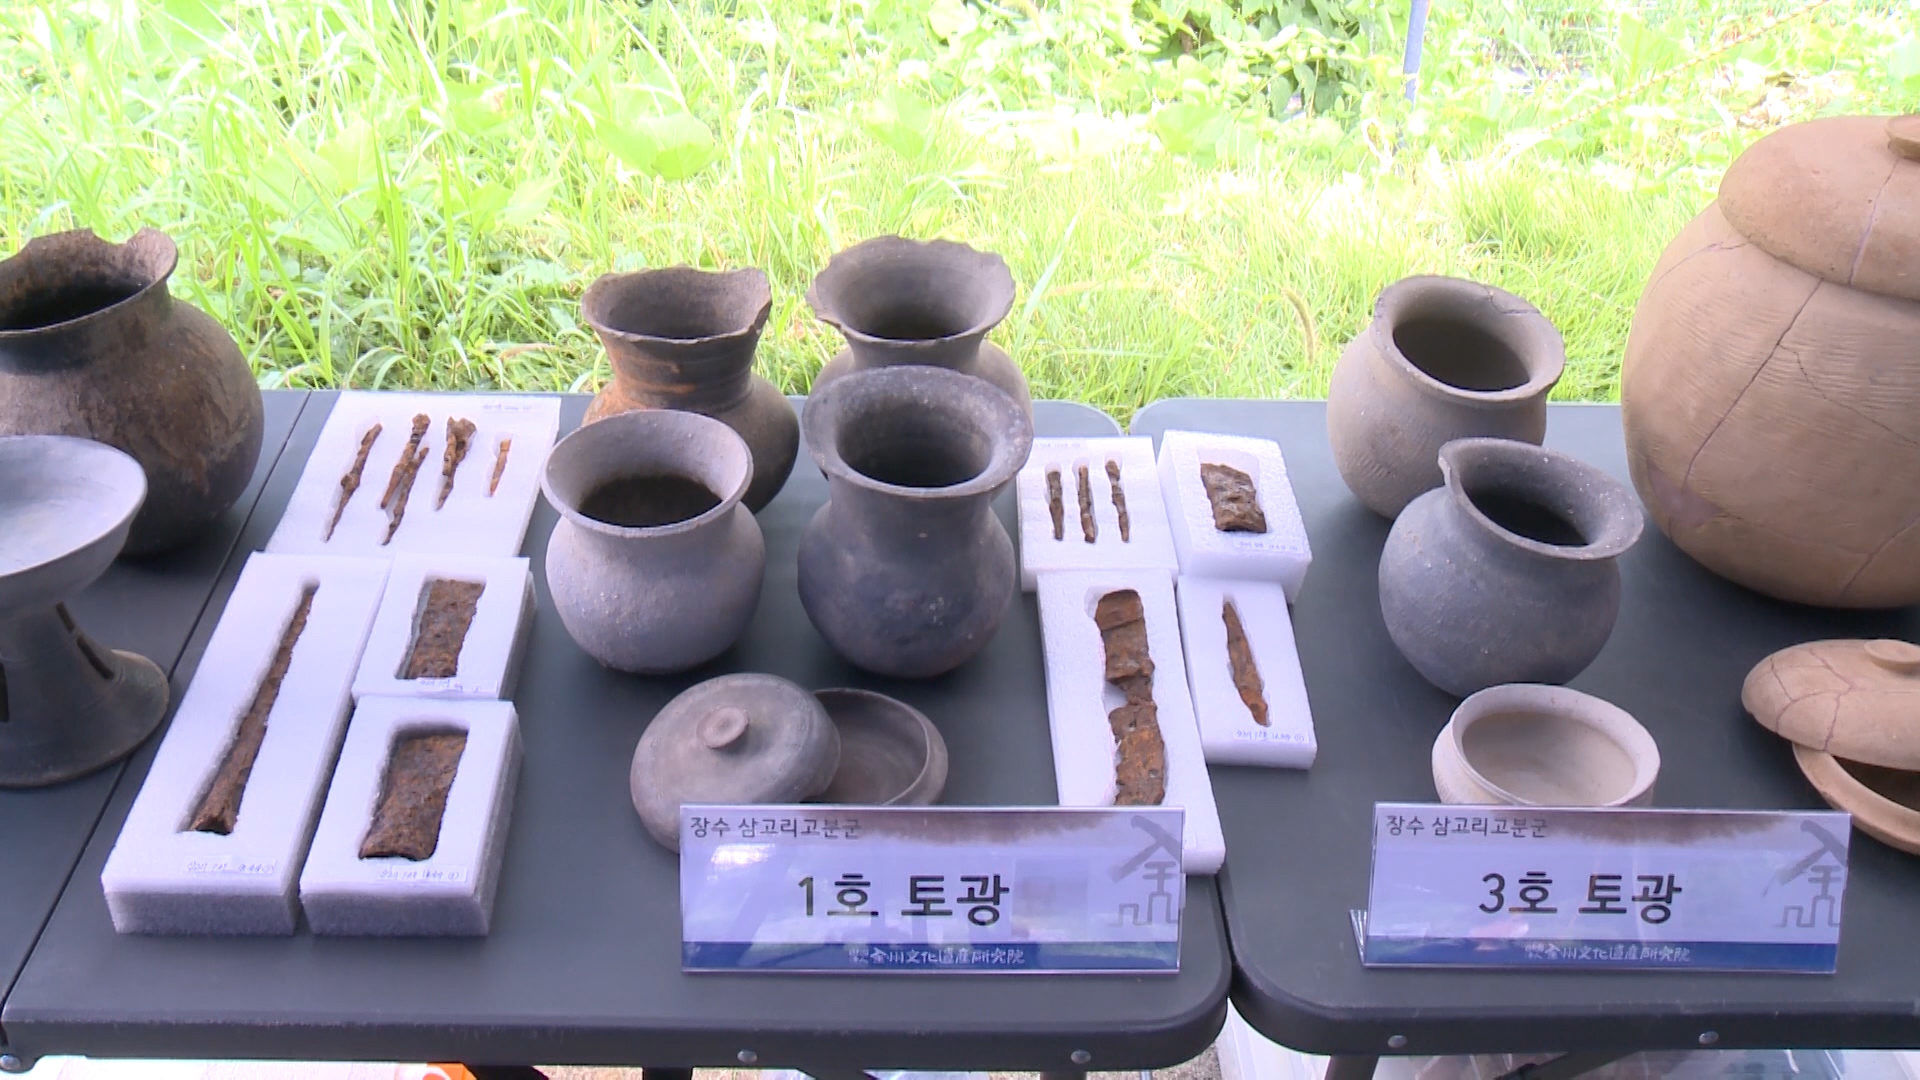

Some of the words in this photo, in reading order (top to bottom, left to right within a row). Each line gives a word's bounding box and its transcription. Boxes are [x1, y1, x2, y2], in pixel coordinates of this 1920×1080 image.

[690, 816, 731, 838] 장수
[737, 816, 862, 840] 삼고리고분군
[1386, 815, 1425, 836] 장수
[1432, 815, 1548, 839] 삼고리고분군
[798, 873, 879, 918] 1호
[901, 873, 1010, 926] 토광
[1478, 870, 1558, 914] 3호
[1578, 873, 1683, 924] 토광
